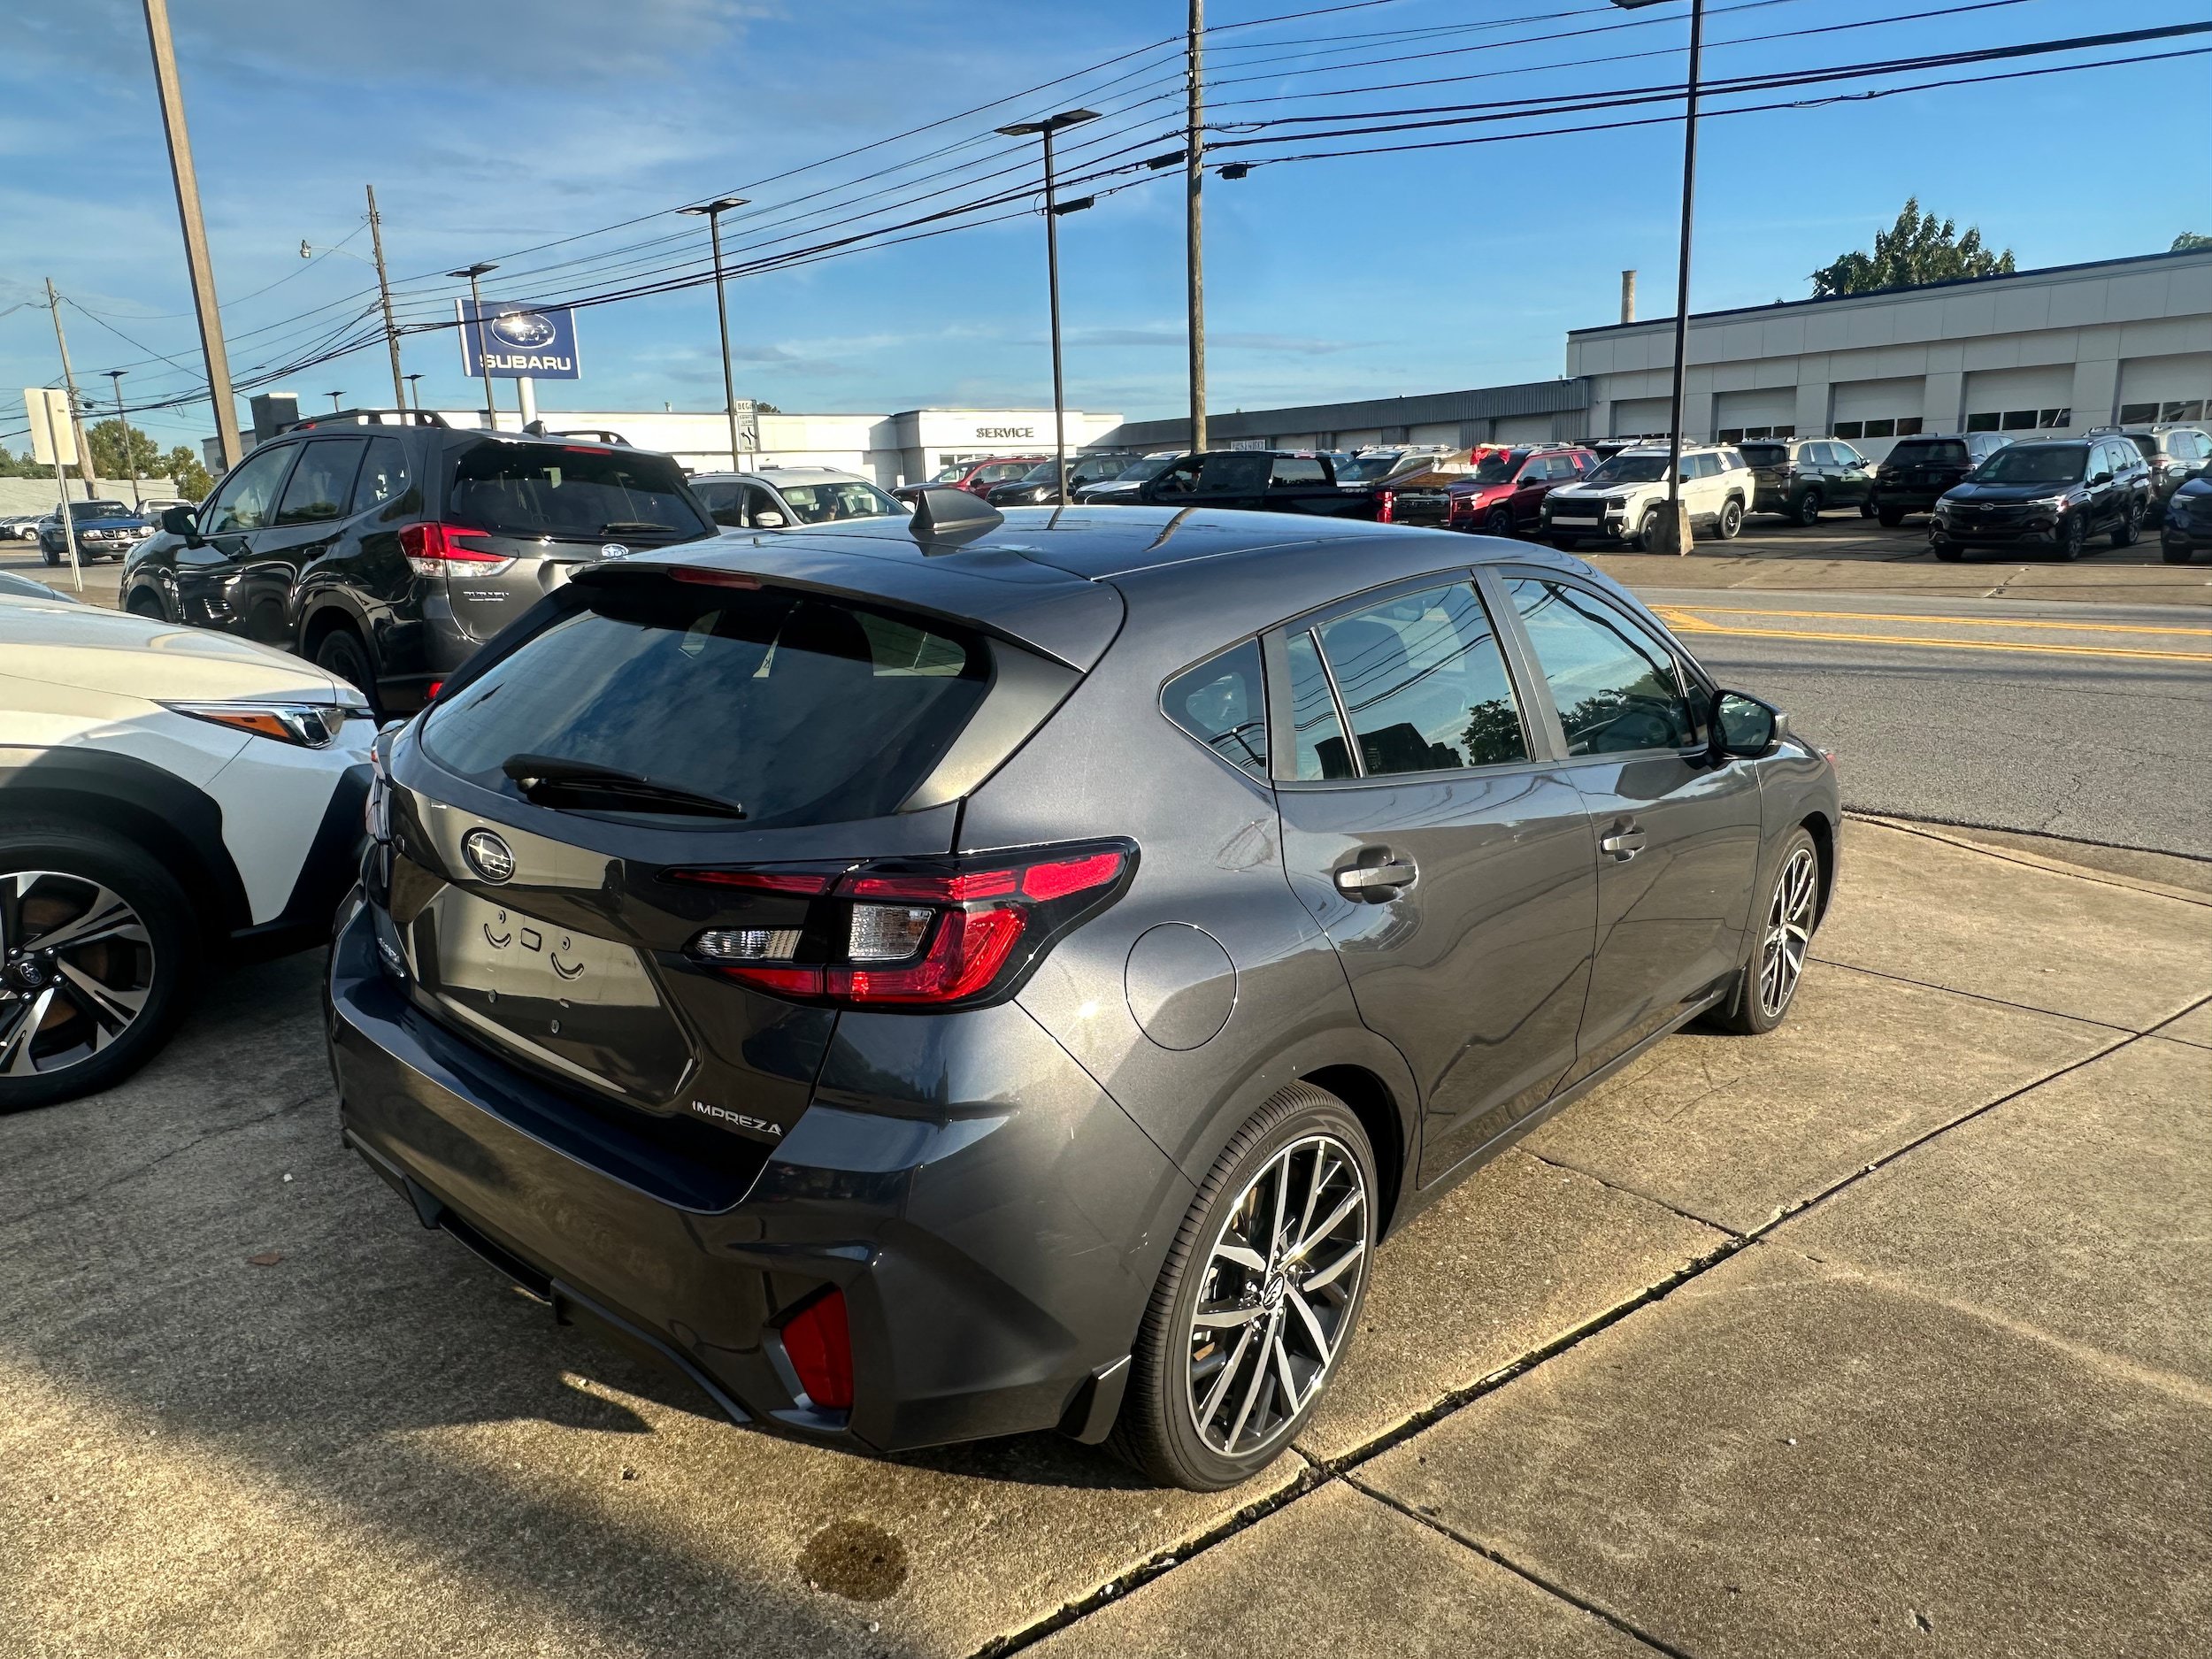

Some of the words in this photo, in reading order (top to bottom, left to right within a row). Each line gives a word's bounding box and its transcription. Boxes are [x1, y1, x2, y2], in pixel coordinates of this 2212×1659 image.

[479, 354, 572, 371] SUBARU
[976, 427, 1034, 438] SERVICE
[692, 1100, 782, 1137] IMPREZA
